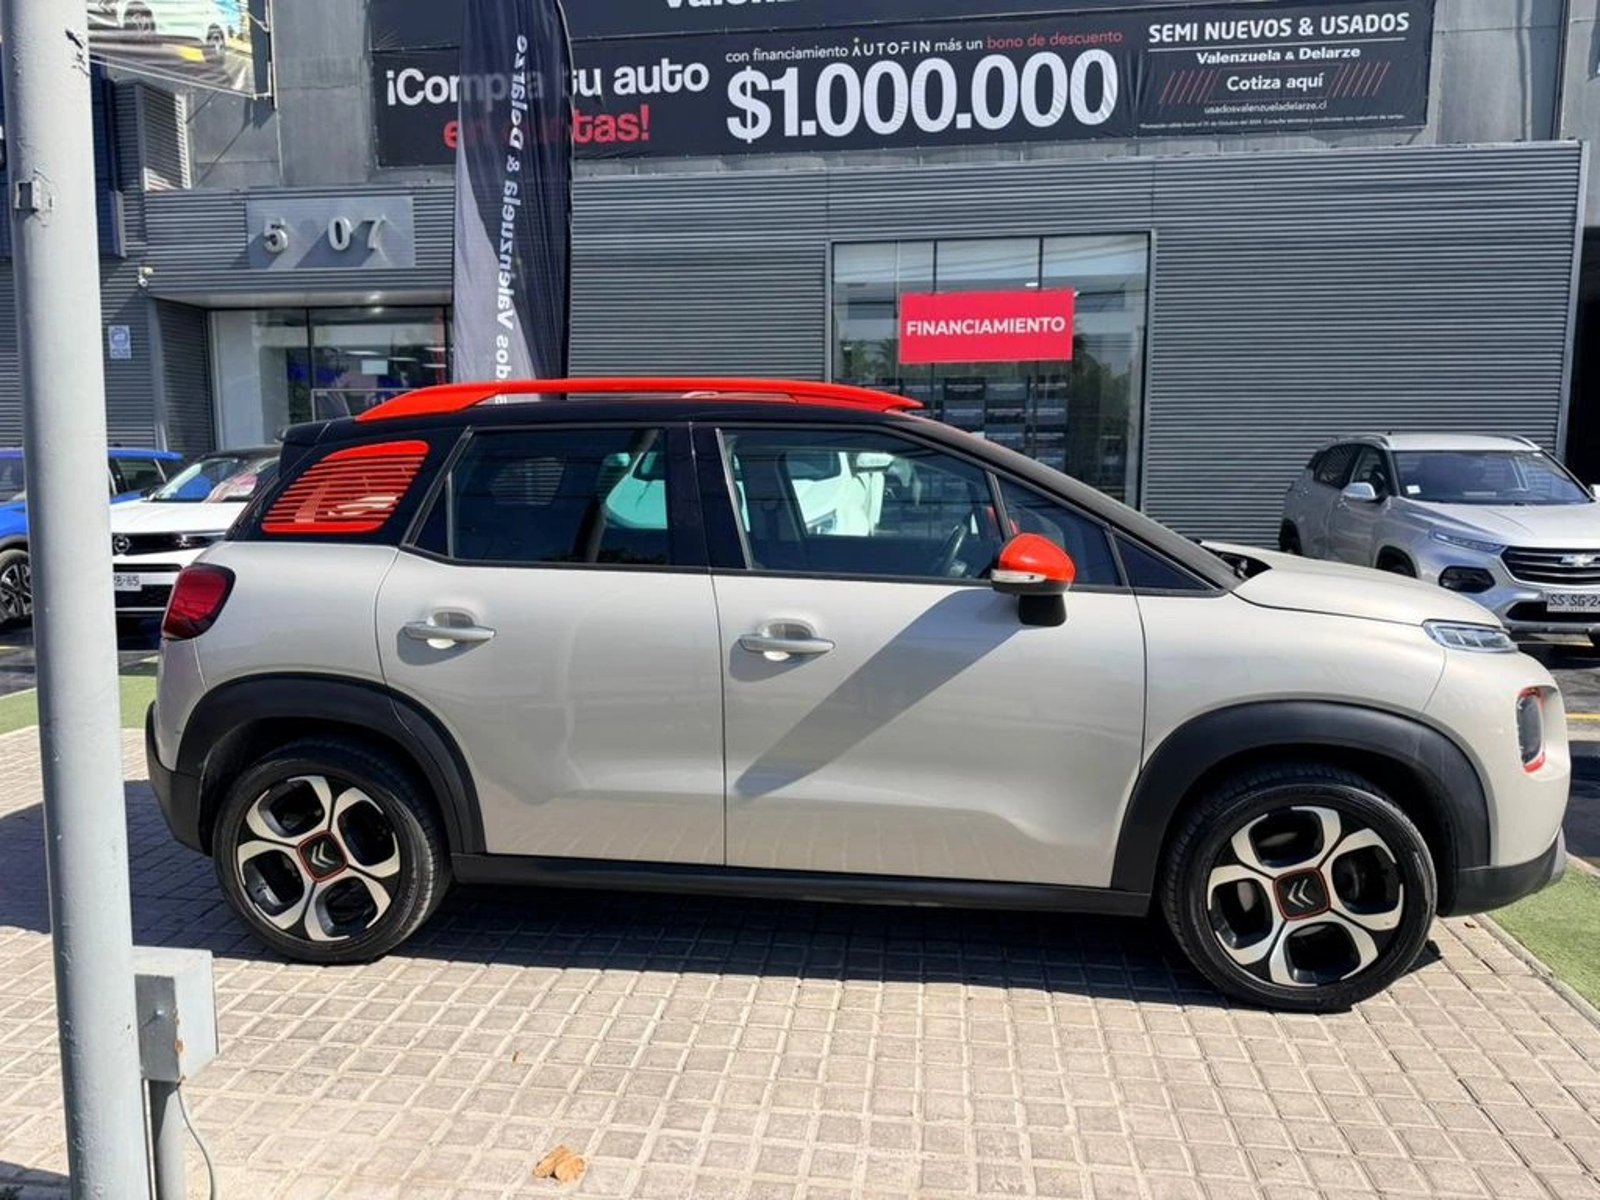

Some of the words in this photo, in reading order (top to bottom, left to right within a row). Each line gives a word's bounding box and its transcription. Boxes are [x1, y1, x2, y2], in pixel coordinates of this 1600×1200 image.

[1149, 23, 1198, 43] SEMI
[1204, 18, 1293, 41] NUEVOS
[1298, 17, 1314, 36] &
[1320, 12, 1410, 36] USADOS
[725, 52, 749, 63] con
[753, 45, 849, 62] financiamiento
[935, 37, 962, 52] más
[966, 39, 983, 50] un
[987, 36, 1024, 49] bono
[1027, 33, 1046, 47] de
[1050, 31, 1123, 46] descuento
[1196, 48, 1281, 65] Valenzuela
[1299, 47, 1361, 60] Delarze
[613, 57, 710, 96] auto
[1227, 75, 1281, 92] Cotiza
[1286, 72, 1325, 94] aquí
[726, 49, 1119, 143] $1.000.000
[264, 217, 288, 252] 5
[906, 316, 1066, 336] FINANCIAMIENTO
